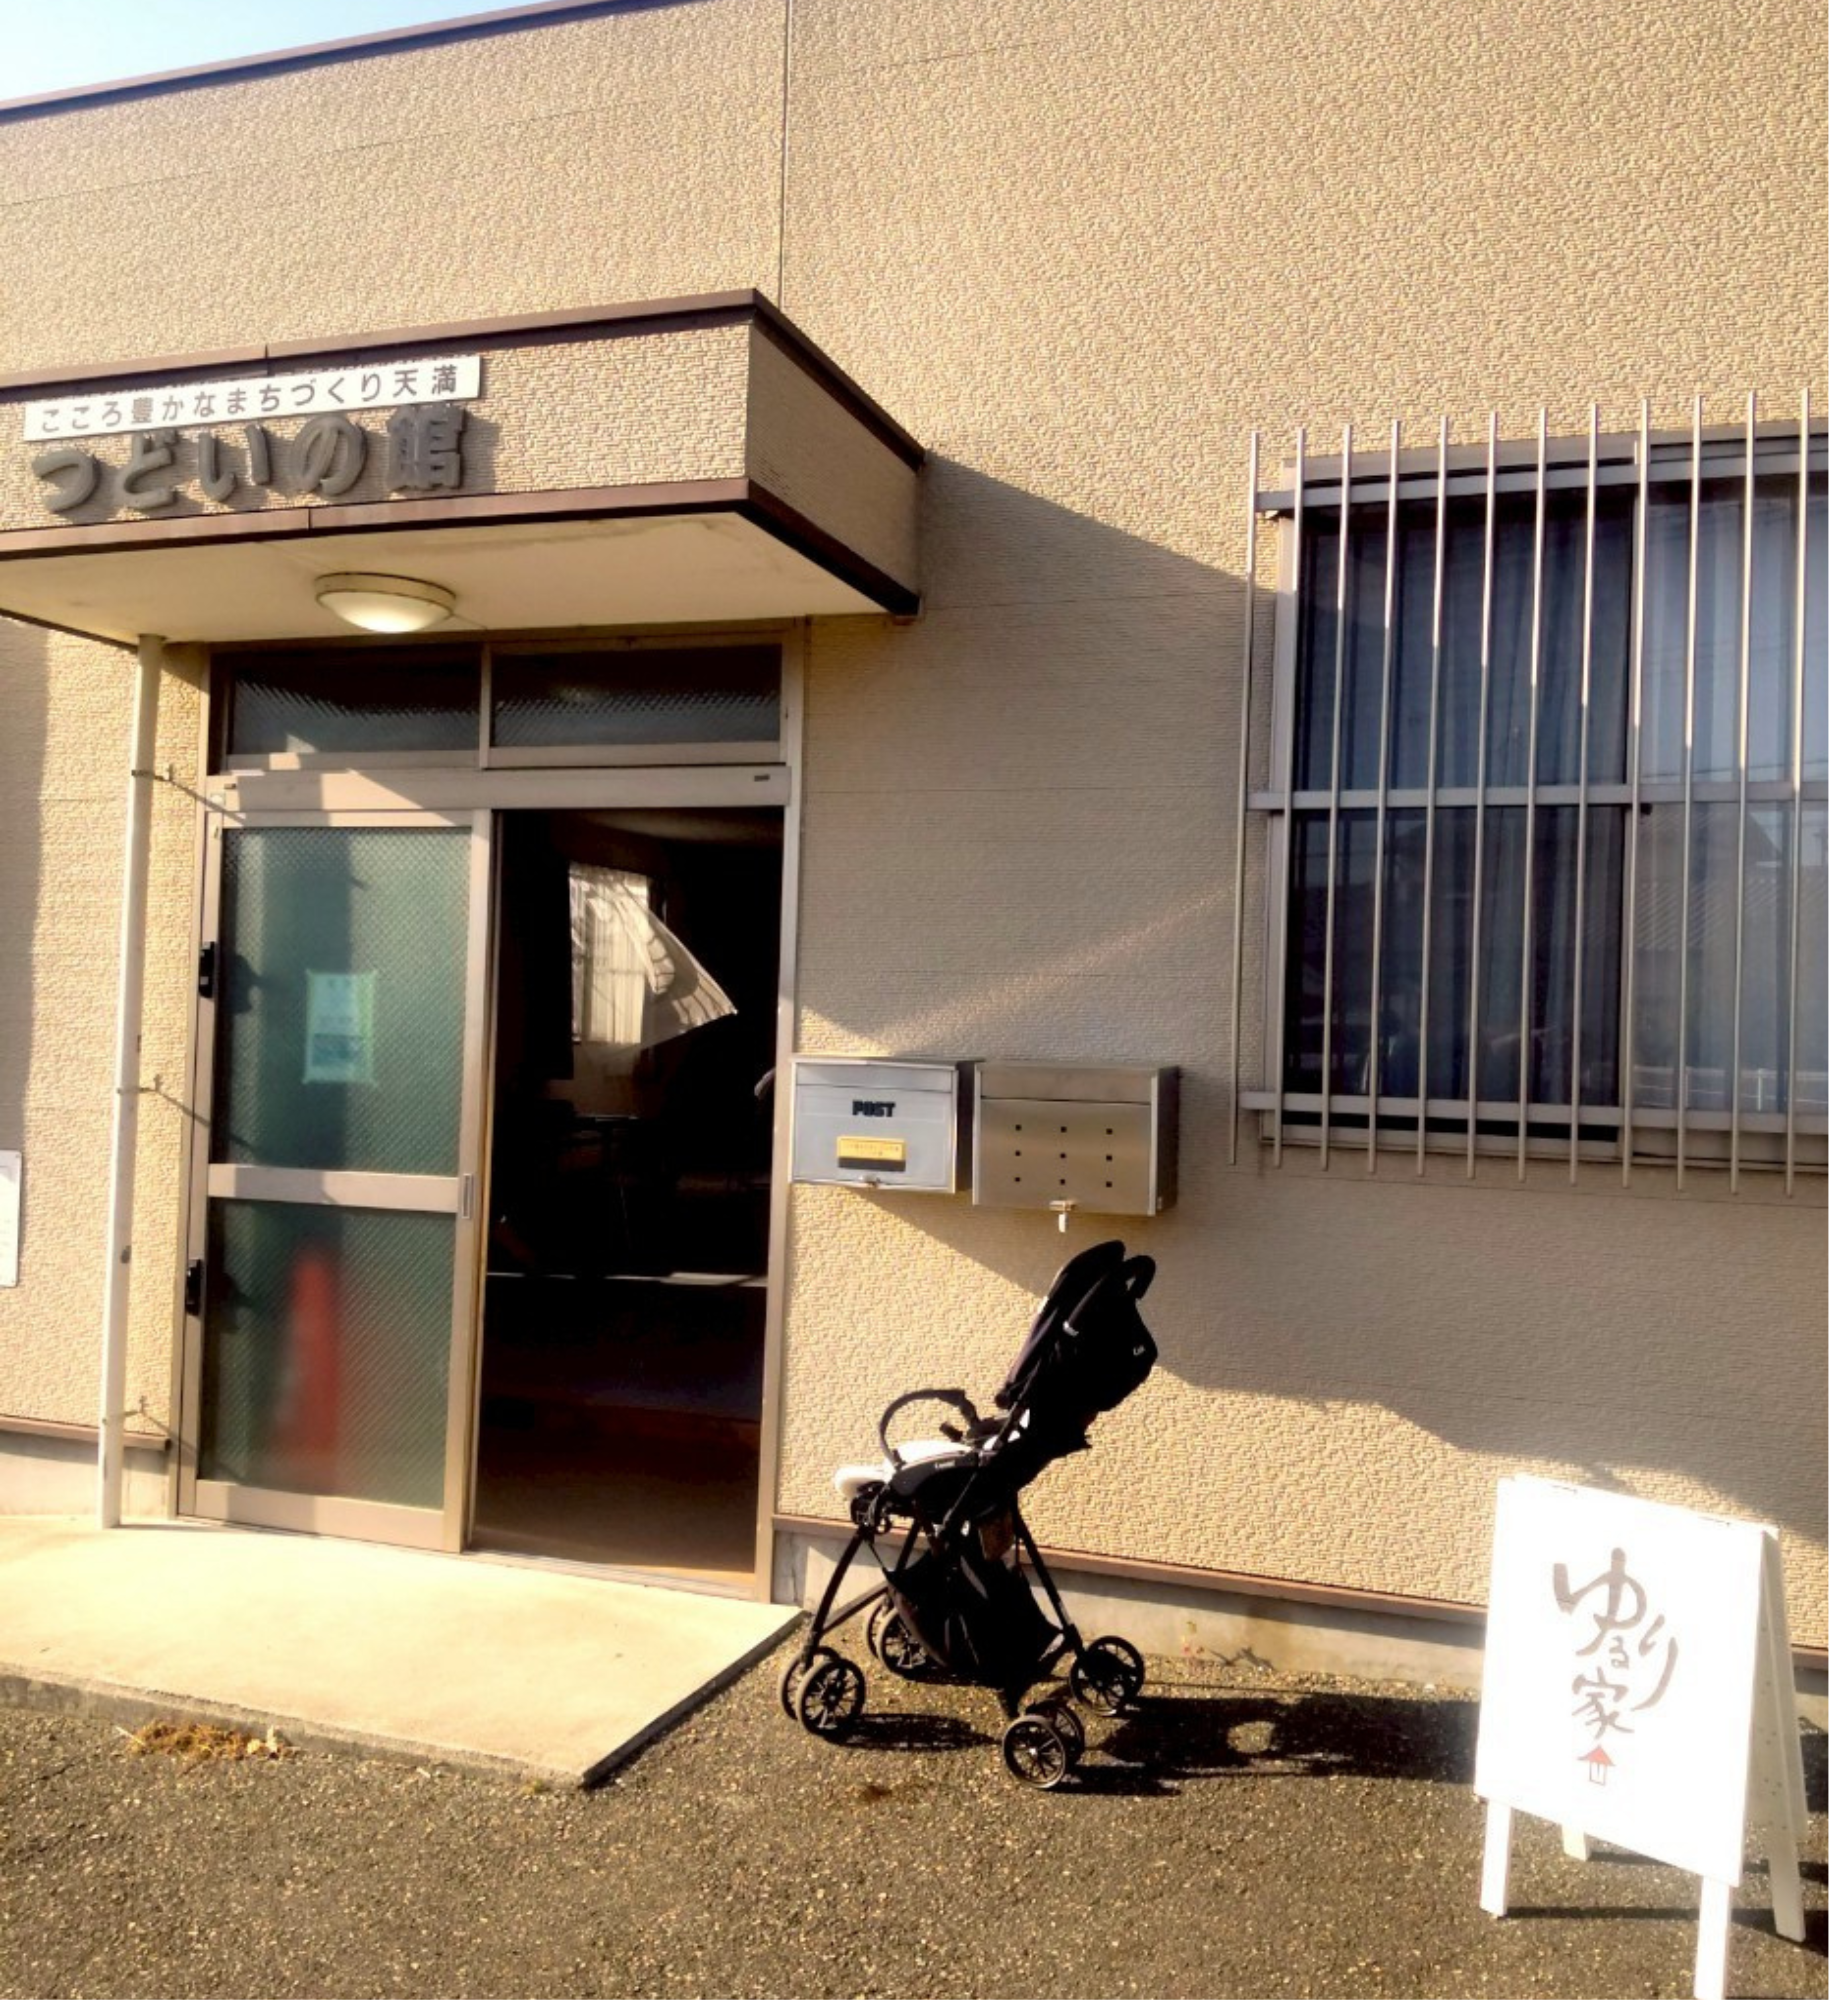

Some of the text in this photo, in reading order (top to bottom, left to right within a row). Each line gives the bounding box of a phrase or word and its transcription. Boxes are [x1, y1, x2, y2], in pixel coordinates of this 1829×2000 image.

[40, 365, 459, 434] こころ豊かなまちづくり天満
[32, 404, 466, 513] つどいの館
[852, 1100, 896, 1118] POST
